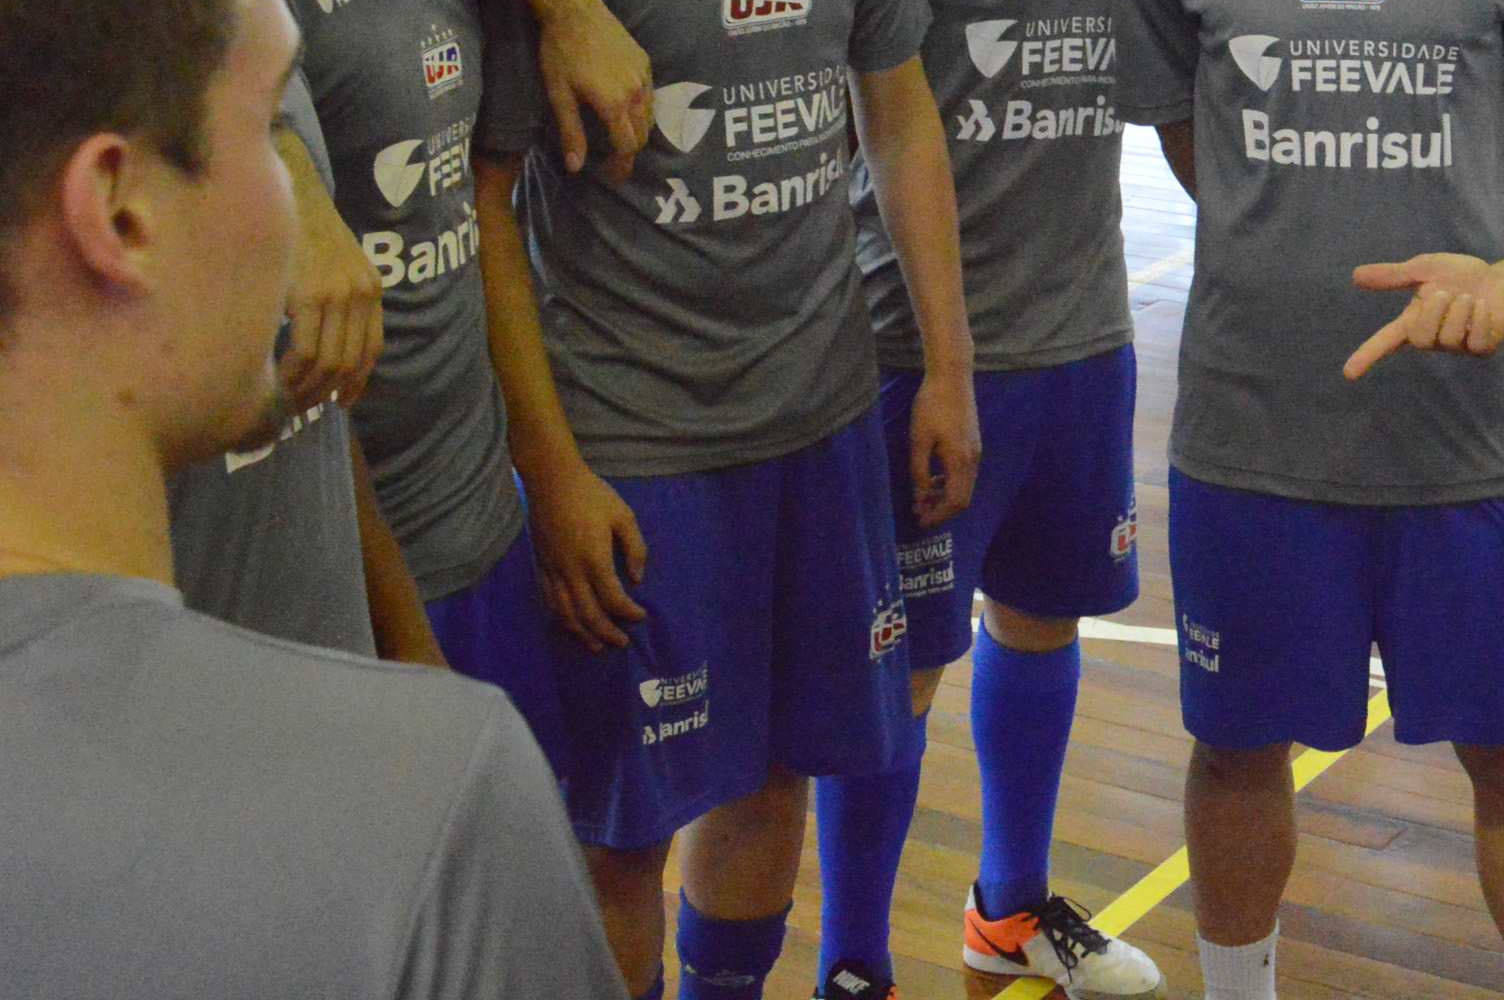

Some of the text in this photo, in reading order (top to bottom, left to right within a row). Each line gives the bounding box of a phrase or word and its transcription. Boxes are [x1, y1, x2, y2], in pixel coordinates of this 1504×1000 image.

[1026, 16, 1113, 37] UNIVERSI
[1021, 38, 1117, 75] FEEVA
[1290, 39, 1459, 61] UNIVERSIDADE
[1291, 59, 1455, 95] FEEVALE
[1242, 109, 1452, 169] Banrisul
